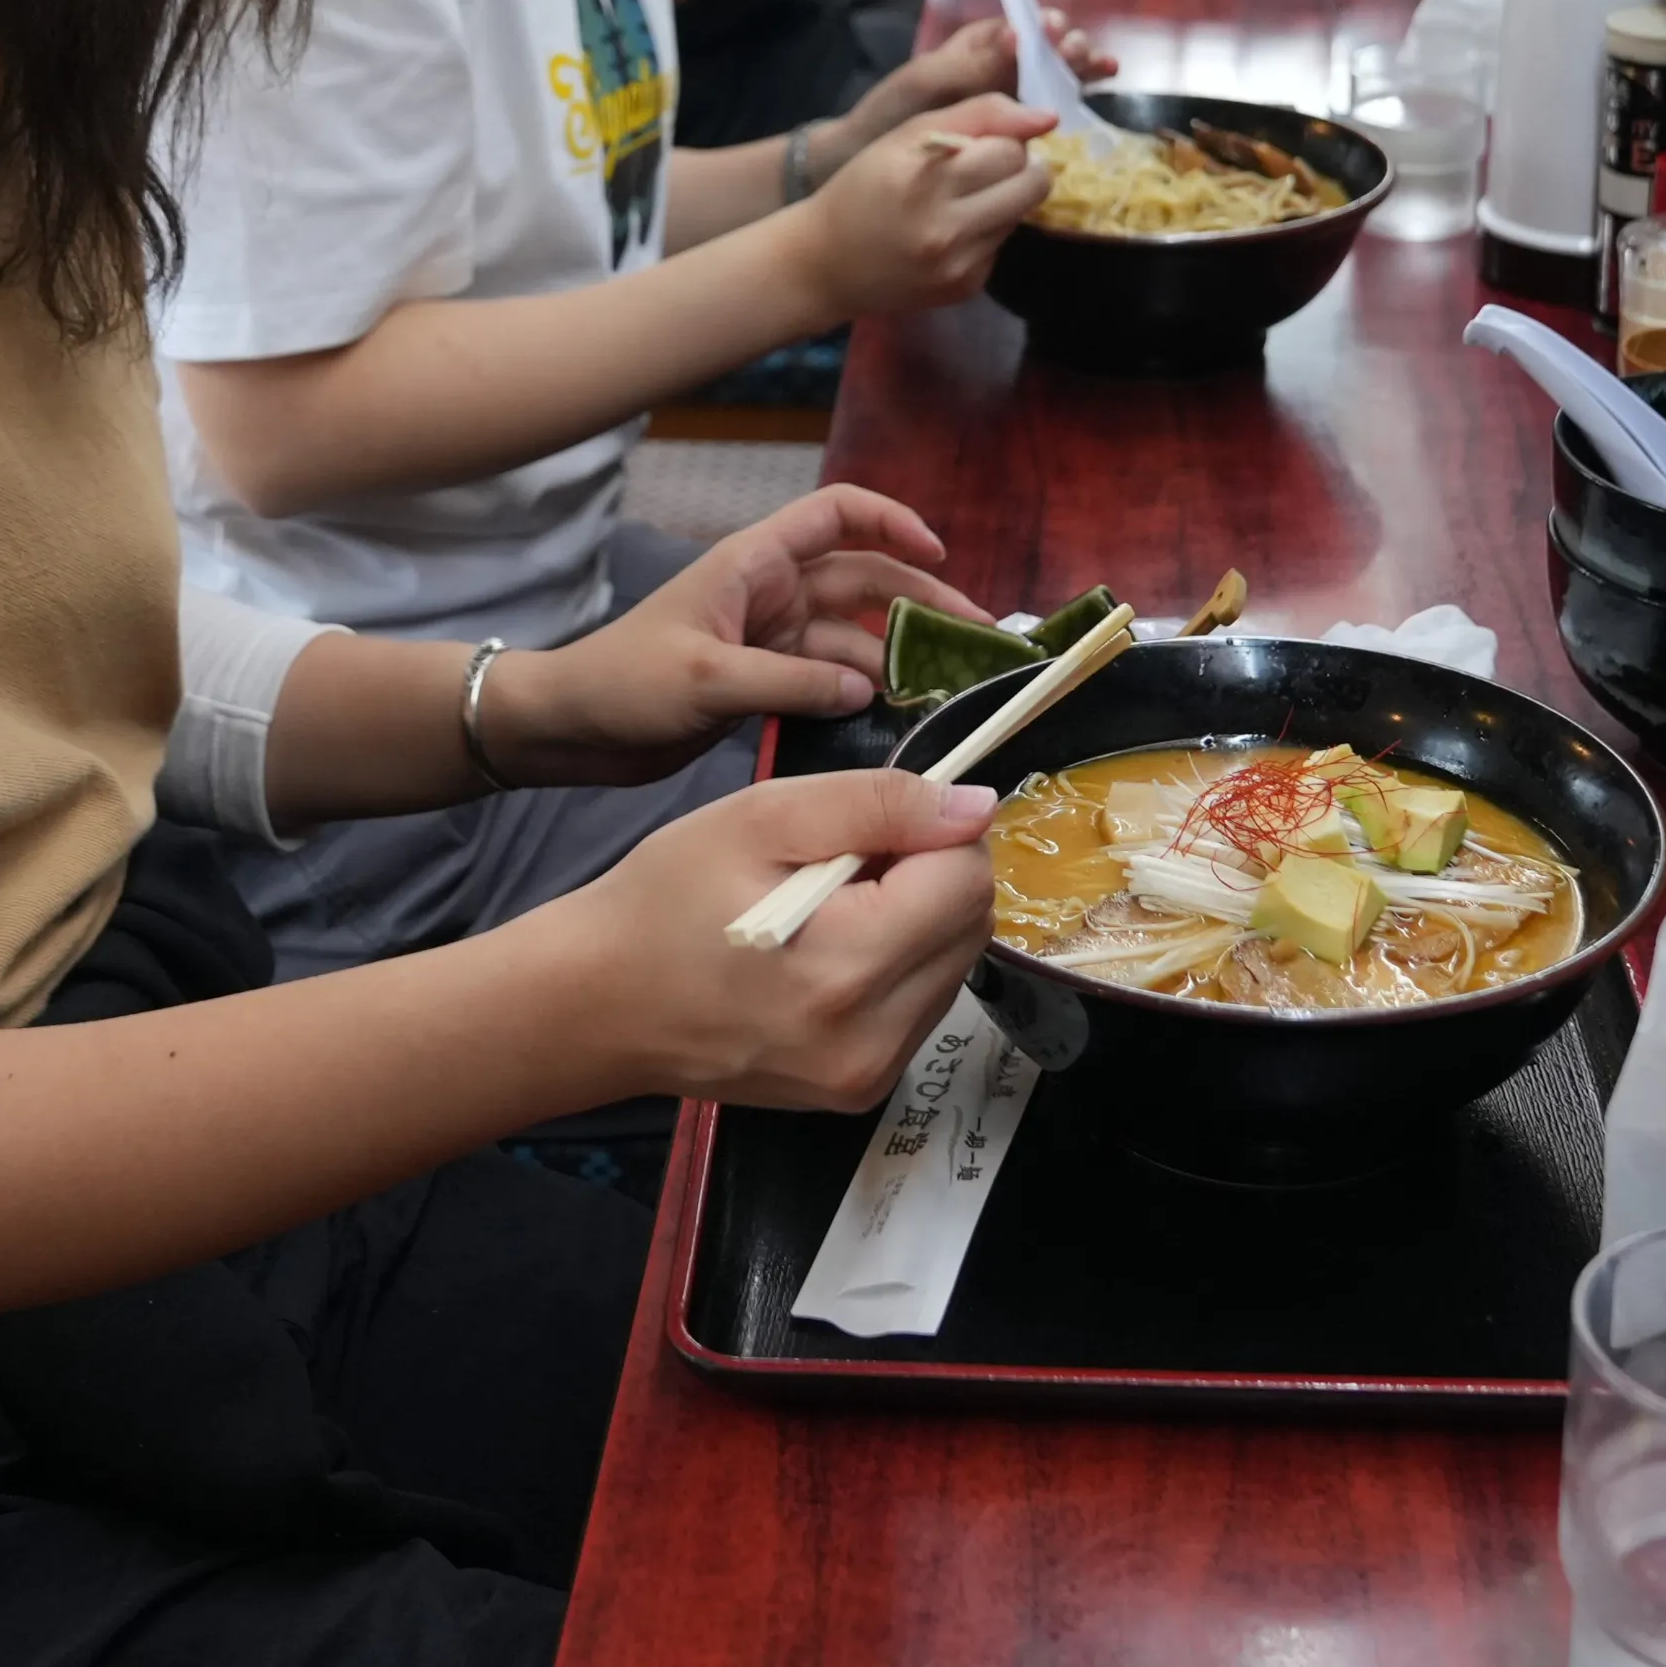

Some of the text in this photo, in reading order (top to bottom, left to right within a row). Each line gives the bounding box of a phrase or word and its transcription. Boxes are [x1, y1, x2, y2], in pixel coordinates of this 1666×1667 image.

[883, 1033, 976, 1157] あさひ食堂
